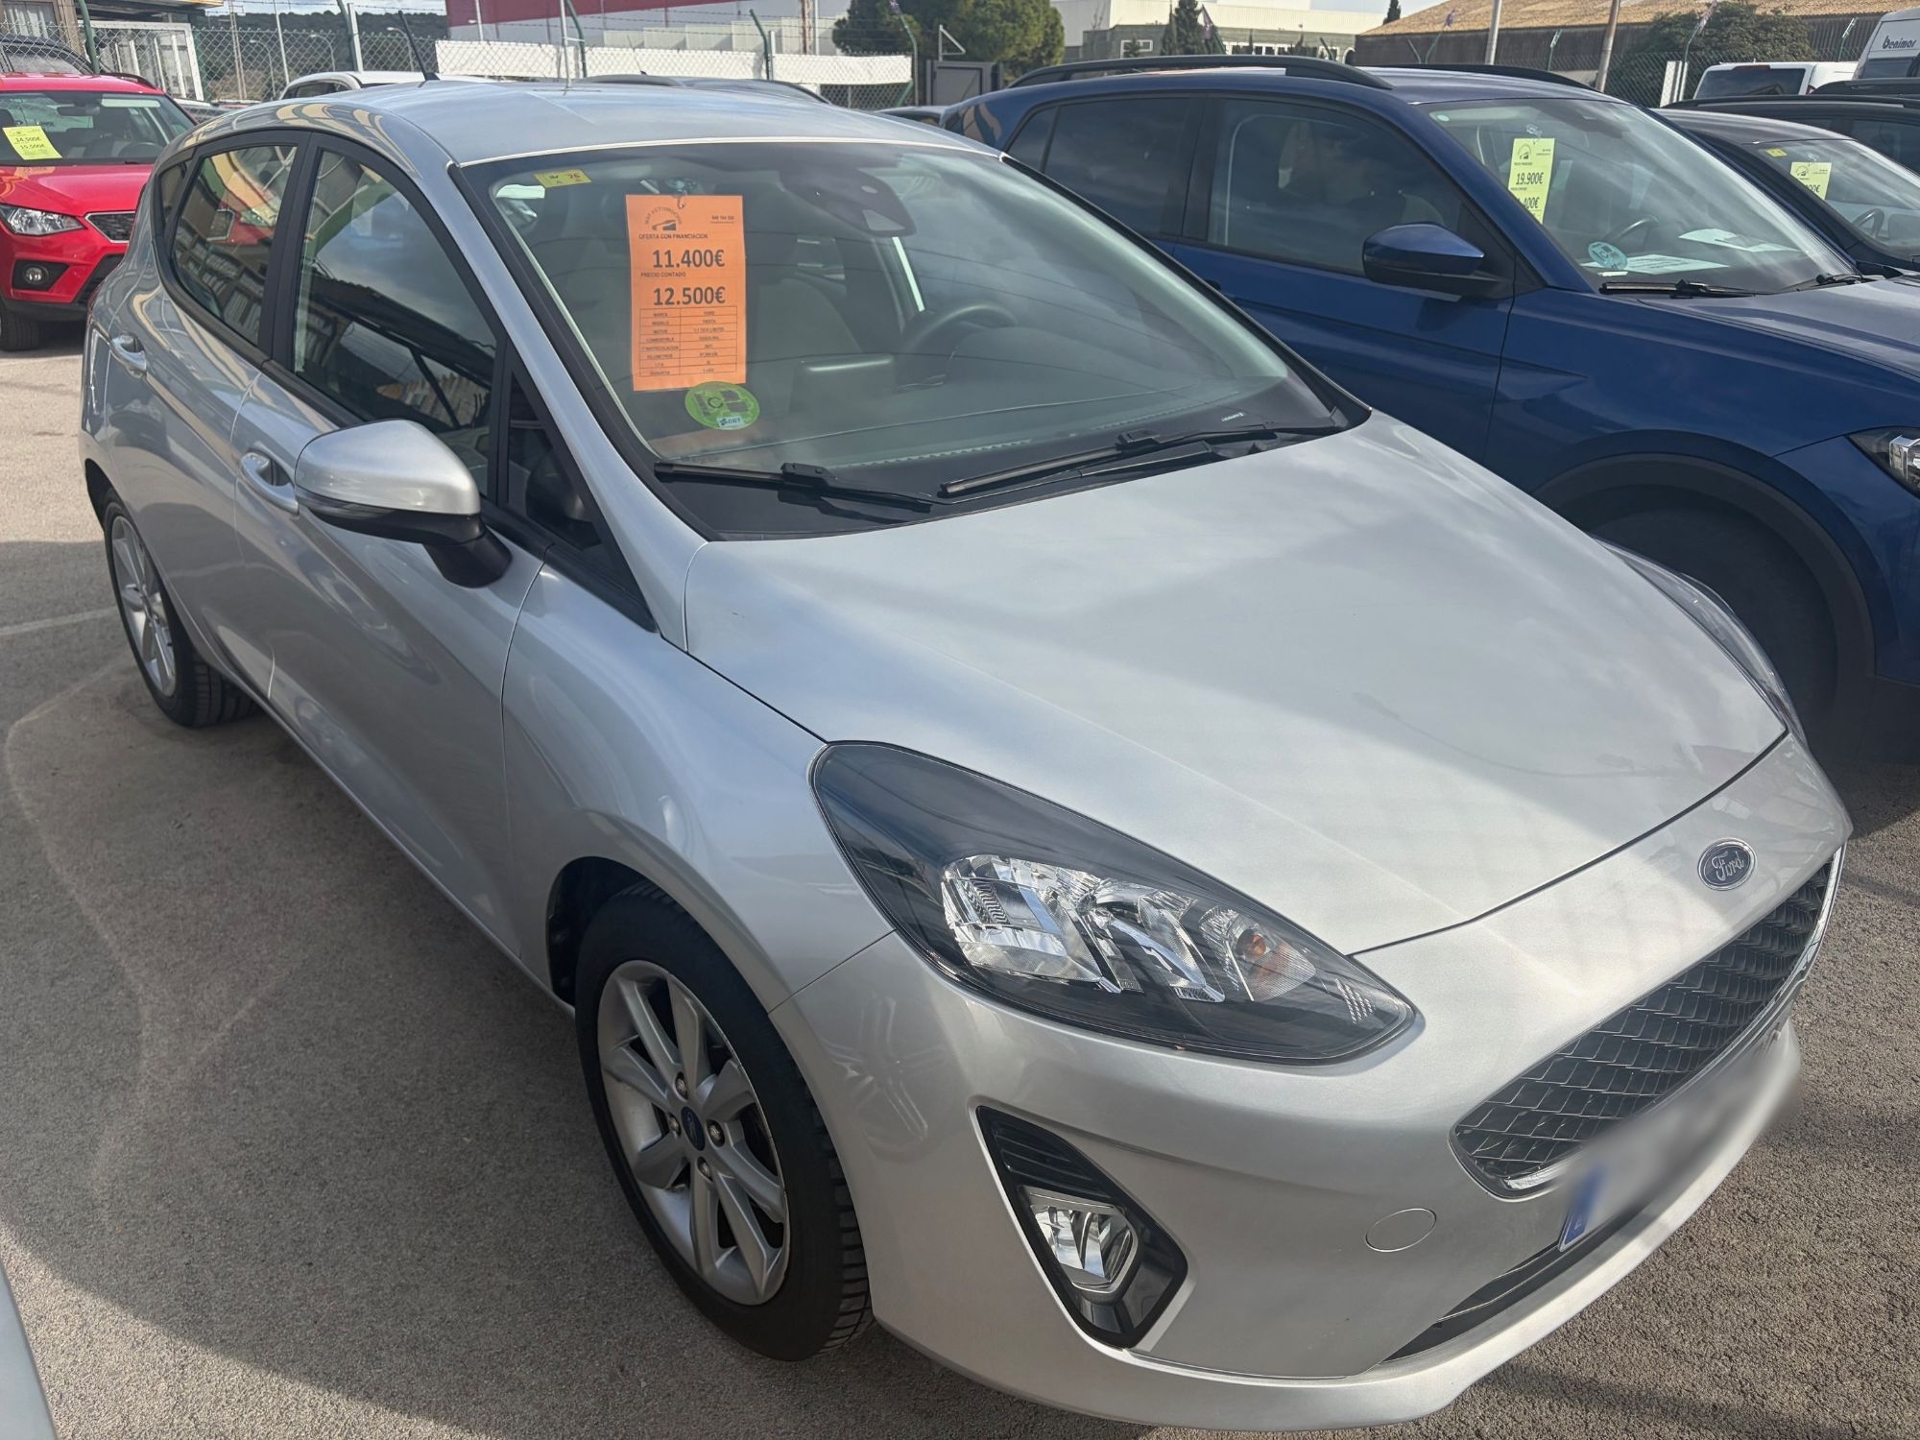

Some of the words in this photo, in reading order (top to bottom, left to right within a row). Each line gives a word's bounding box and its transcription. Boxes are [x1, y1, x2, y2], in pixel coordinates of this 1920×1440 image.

[1516, 172, 1544, 185] 19.900€
[652, 249, 726, 269] 11.400€
[653, 286, 726, 306] 12.500€
[707, 396, 724, 409] C
[1711, 850, 1745, 881] Ford
